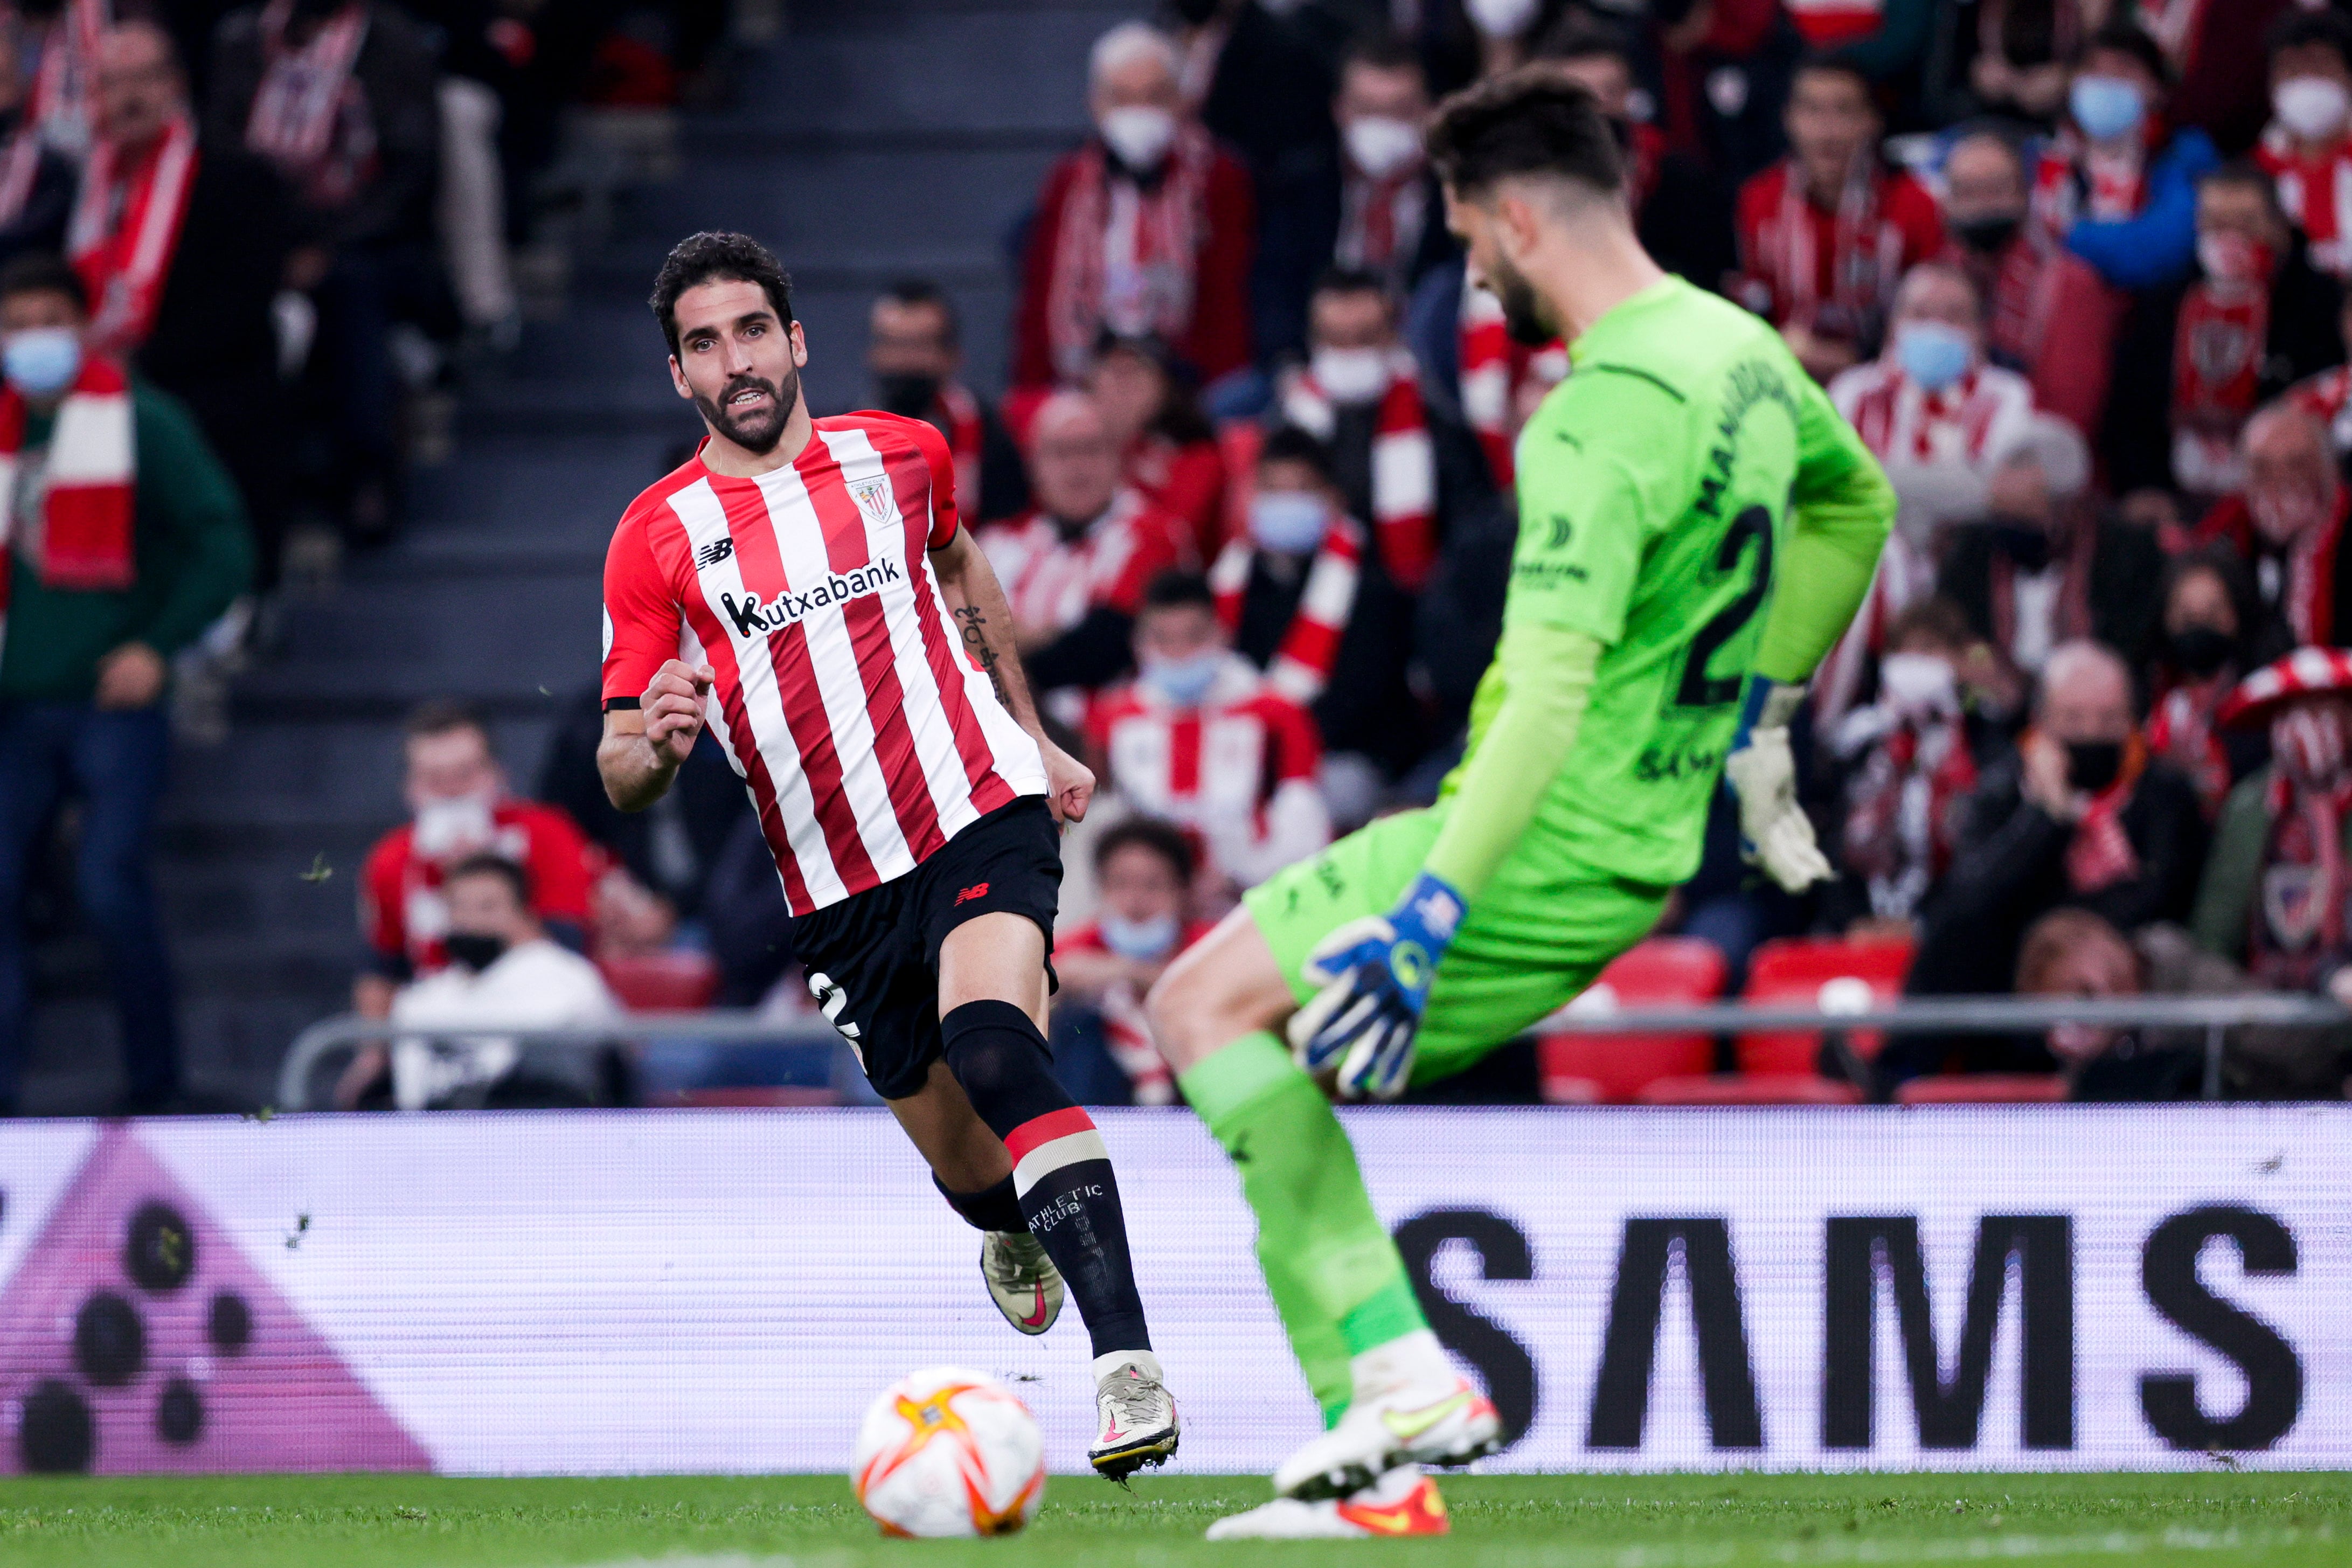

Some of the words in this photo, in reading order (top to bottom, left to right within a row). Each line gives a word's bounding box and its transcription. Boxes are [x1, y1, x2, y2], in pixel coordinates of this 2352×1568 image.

[721, 557, 899, 638] Kutxabank
[808, 972, 861, 1038] 2
[1029, 1184, 1103, 1234] ATHLETIC
[1044, 1202, 1080, 1232] CLUB
